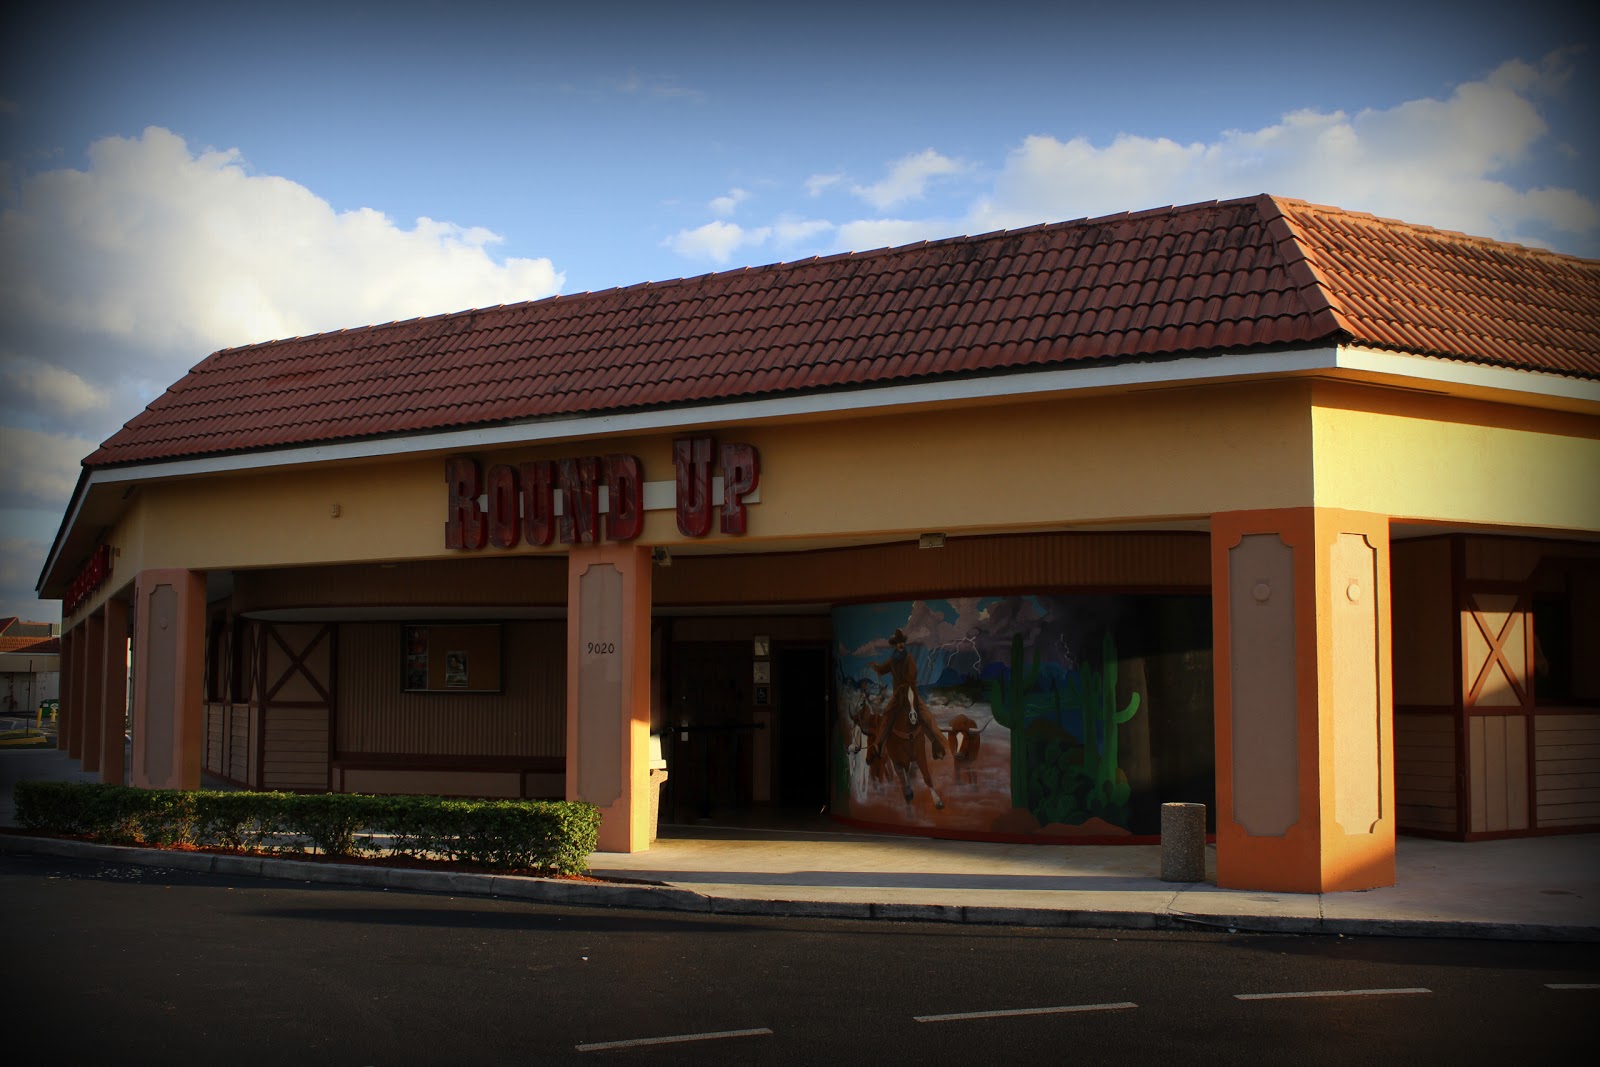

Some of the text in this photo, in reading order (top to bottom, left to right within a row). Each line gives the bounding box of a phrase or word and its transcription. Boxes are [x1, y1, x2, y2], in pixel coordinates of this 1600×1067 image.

[445, 436, 759, 549] ROUND UP
[587, 642, 615, 654] 9020
